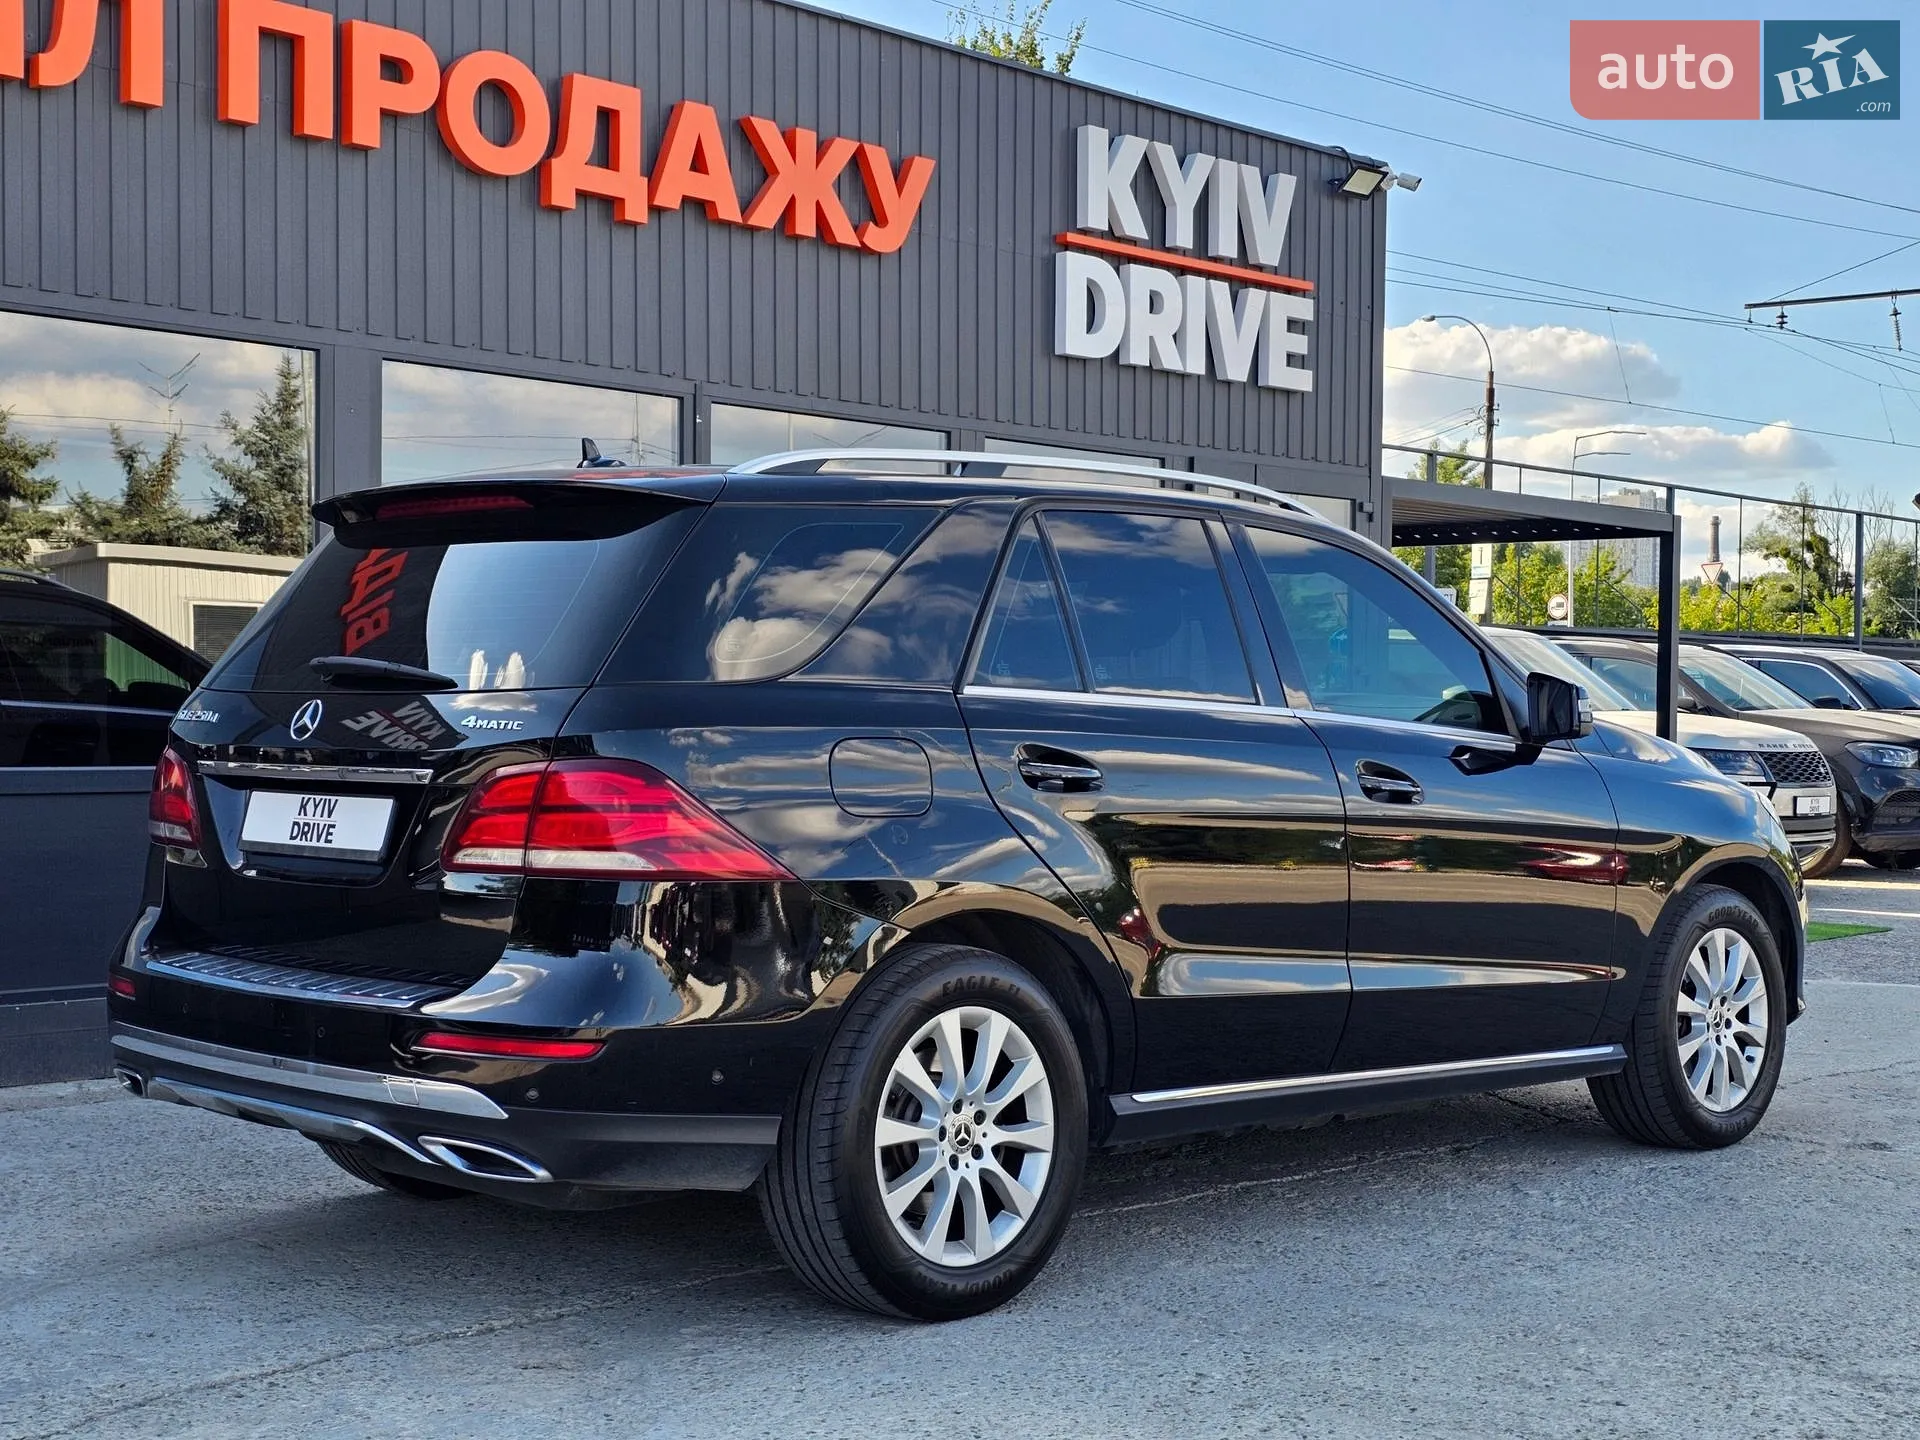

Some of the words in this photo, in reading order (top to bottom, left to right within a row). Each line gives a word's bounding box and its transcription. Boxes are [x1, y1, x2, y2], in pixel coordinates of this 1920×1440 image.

[217, 0, 936, 255] ПРОДАЖУ
[1076, 124, 1297, 267] KYIV
[1055, 250, 1314, 392] DRIVE
[461, 715, 524, 730] 4MATIC
[298, 796, 339, 818] KYIV
[289, 821, 336, 844] DRIVE
[942, 975, 1000, 998] EAGLE
